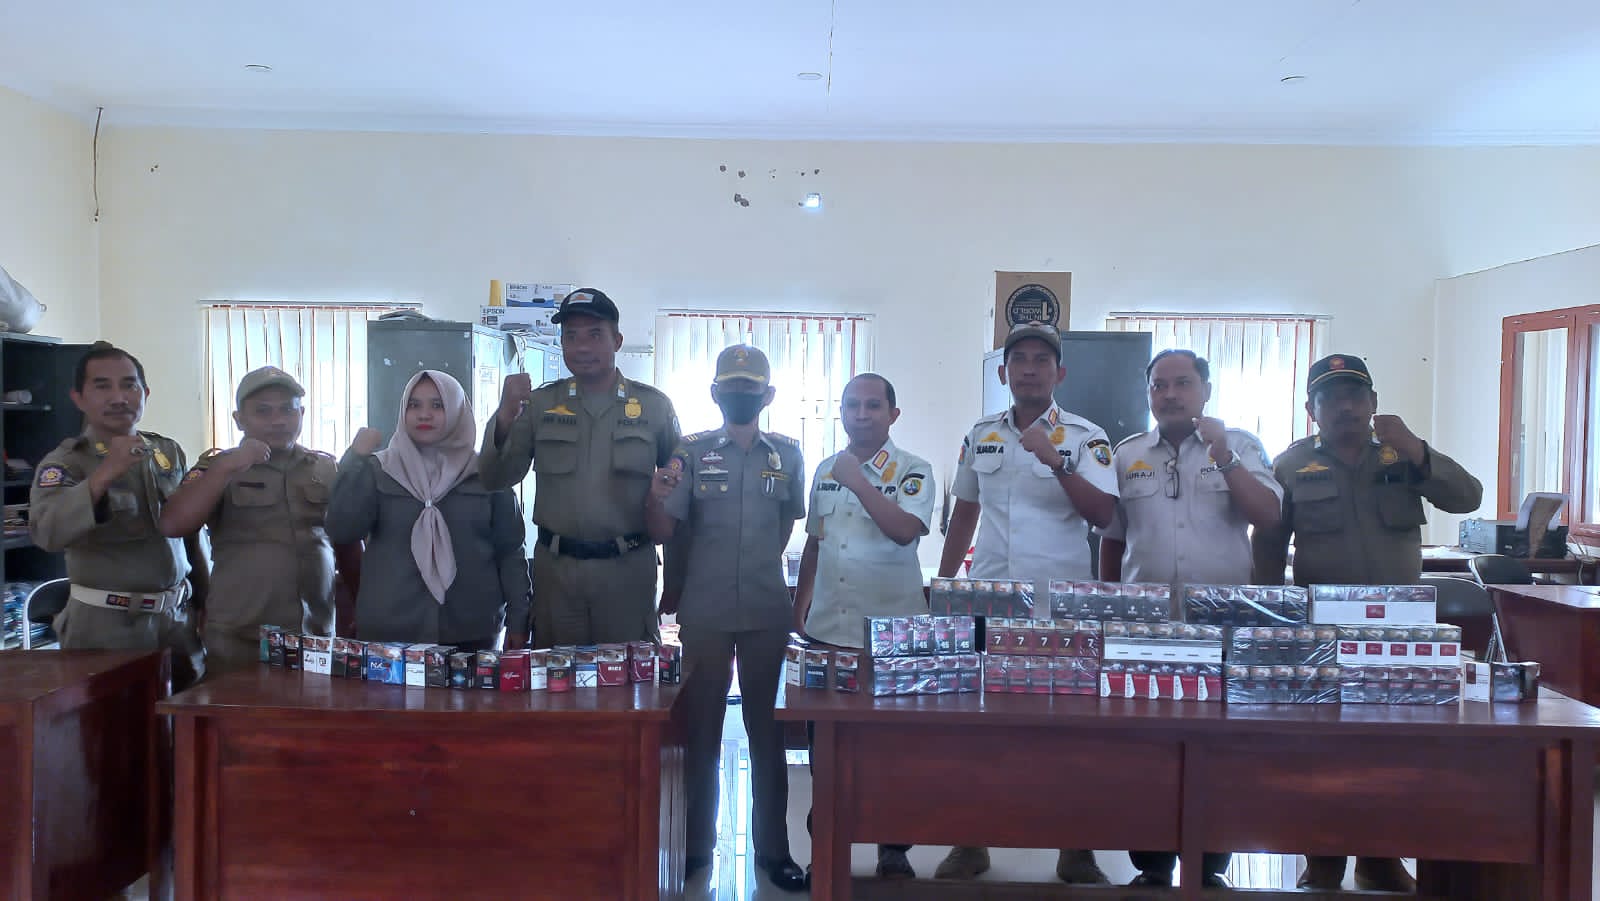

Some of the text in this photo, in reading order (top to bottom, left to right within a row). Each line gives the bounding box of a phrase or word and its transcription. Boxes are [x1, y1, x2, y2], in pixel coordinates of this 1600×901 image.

[994, 635, 1002, 644] 7
[1017, 636, 1025, 645] 7
[1040, 637, 1048, 646] 7
[1063, 638, 1071, 647] 7
